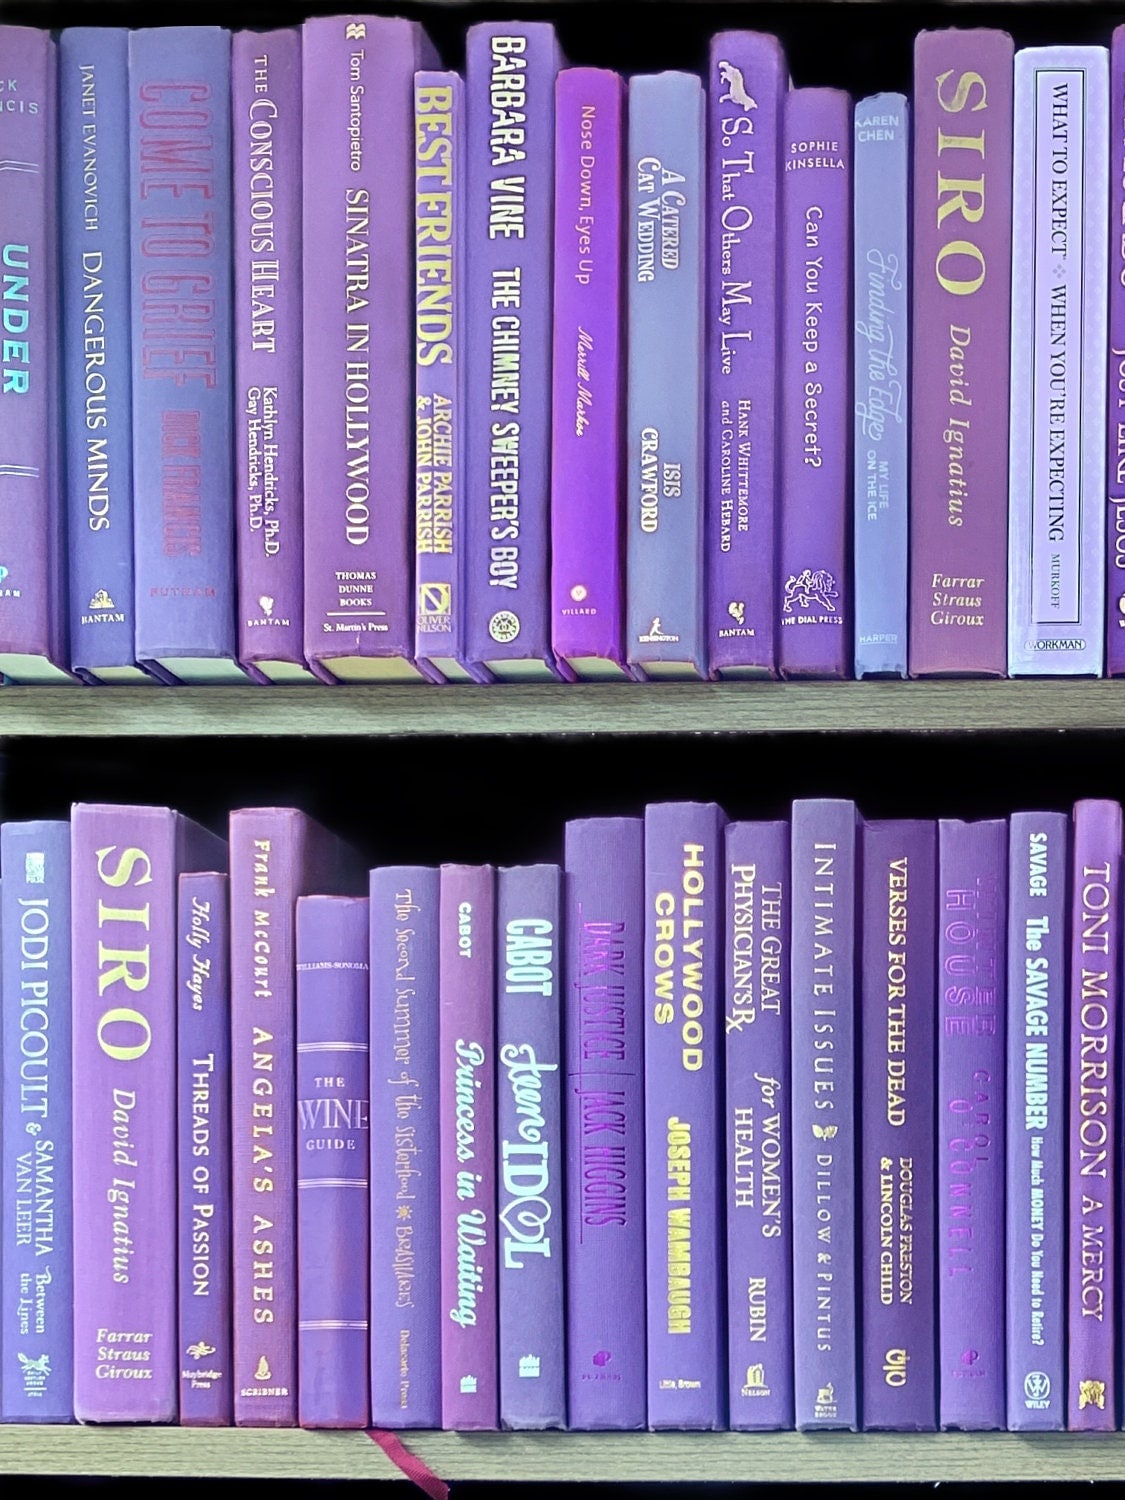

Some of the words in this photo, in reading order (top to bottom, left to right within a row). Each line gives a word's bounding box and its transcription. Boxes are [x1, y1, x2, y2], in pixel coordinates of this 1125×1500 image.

[80, 64, 97, 116] JANET
[254, 54, 269, 94] THE
[349, 49, 364, 82] Tom
[487, 34, 529, 167] BARBARA
[346, 84, 366, 172] Santopietro
[790, 140, 838, 154] SOPHIE
[1052, 83, 1068, 142] WHAT
[82, 120, 99, 231] EVANOVICH
[248, 96, 280, 253] CONSCIOUS
[785, 157, 846, 172] KINSELLA
[935, 69, 988, 296] SIRO
[1052, 147, 1068, 174] TO
[487, 174, 527, 239] VINE
[344, 188, 370, 313] SINATRA
[490, 267, 522, 309] THE
[81, 250, 107, 430] DANGEROUS
[249, 259, 281, 353] HEART
[344, 323, 371, 353] IN
[1050, 284, 1067, 345] WHEN
[489, 314, 522, 416] CHIMNEY
[1049, 348, 1067, 426] YOU'RE
[85, 438, 110, 531] MINDS
[345, 361, 371, 545] HOLLYWOOD
[488, 422, 521, 540] SWEEPER'S
[1048, 430, 1065, 541] EXPECTING
[335, 570, 378, 582] THOMAS
[338, 583, 374, 594] DUNNE
[339, 597, 373, 607] BOOKS
[487, 545, 521, 591] BOY
[931, 573, 985, 589] Farrar
[932, 591, 982, 608] Straus
[1050, 553, 1061, 608] MURKOFF
[81, 613, 125, 625] BANTAM
[930, 610, 985, 626] Giroux
[888, 856, 908, 946] VERSES
[1081, 861, 1111, 955] TONI
[95, 845, 153, 1061] SIRO
[505, 918, 553, 997] CABOT
[654, 891, 676, 1025] CROWS
[681, 843, 705, 1071] HOLLYWOOD
[887, 950, 906, 1002] FOR
[887, 1003, 906, 1054] THE
[192, 1053, 215, 1157] THREADS
[252, 1026, 275, 1193] ANGELA'S
[314, 1076, 345, 1088] THE
[887, 1058, 906, 1127] DEAD
[1079, 968, 1109, 1179] MORRISON
[192, 1165, 210, 1194] OF
[305, 1138, 356, 1151] GUIDE
[667, 1116, 692, 1201] JOSEPH
[1081, 1194, 1104, 1215] A
[192, 1204, 214, 1296] PASSION
[252, 1214, 274, 1324] ASHES
[667, 1207, 692, 1334] WAMBAUGH
[1081, 1224, 1106, 1322] MERCY
